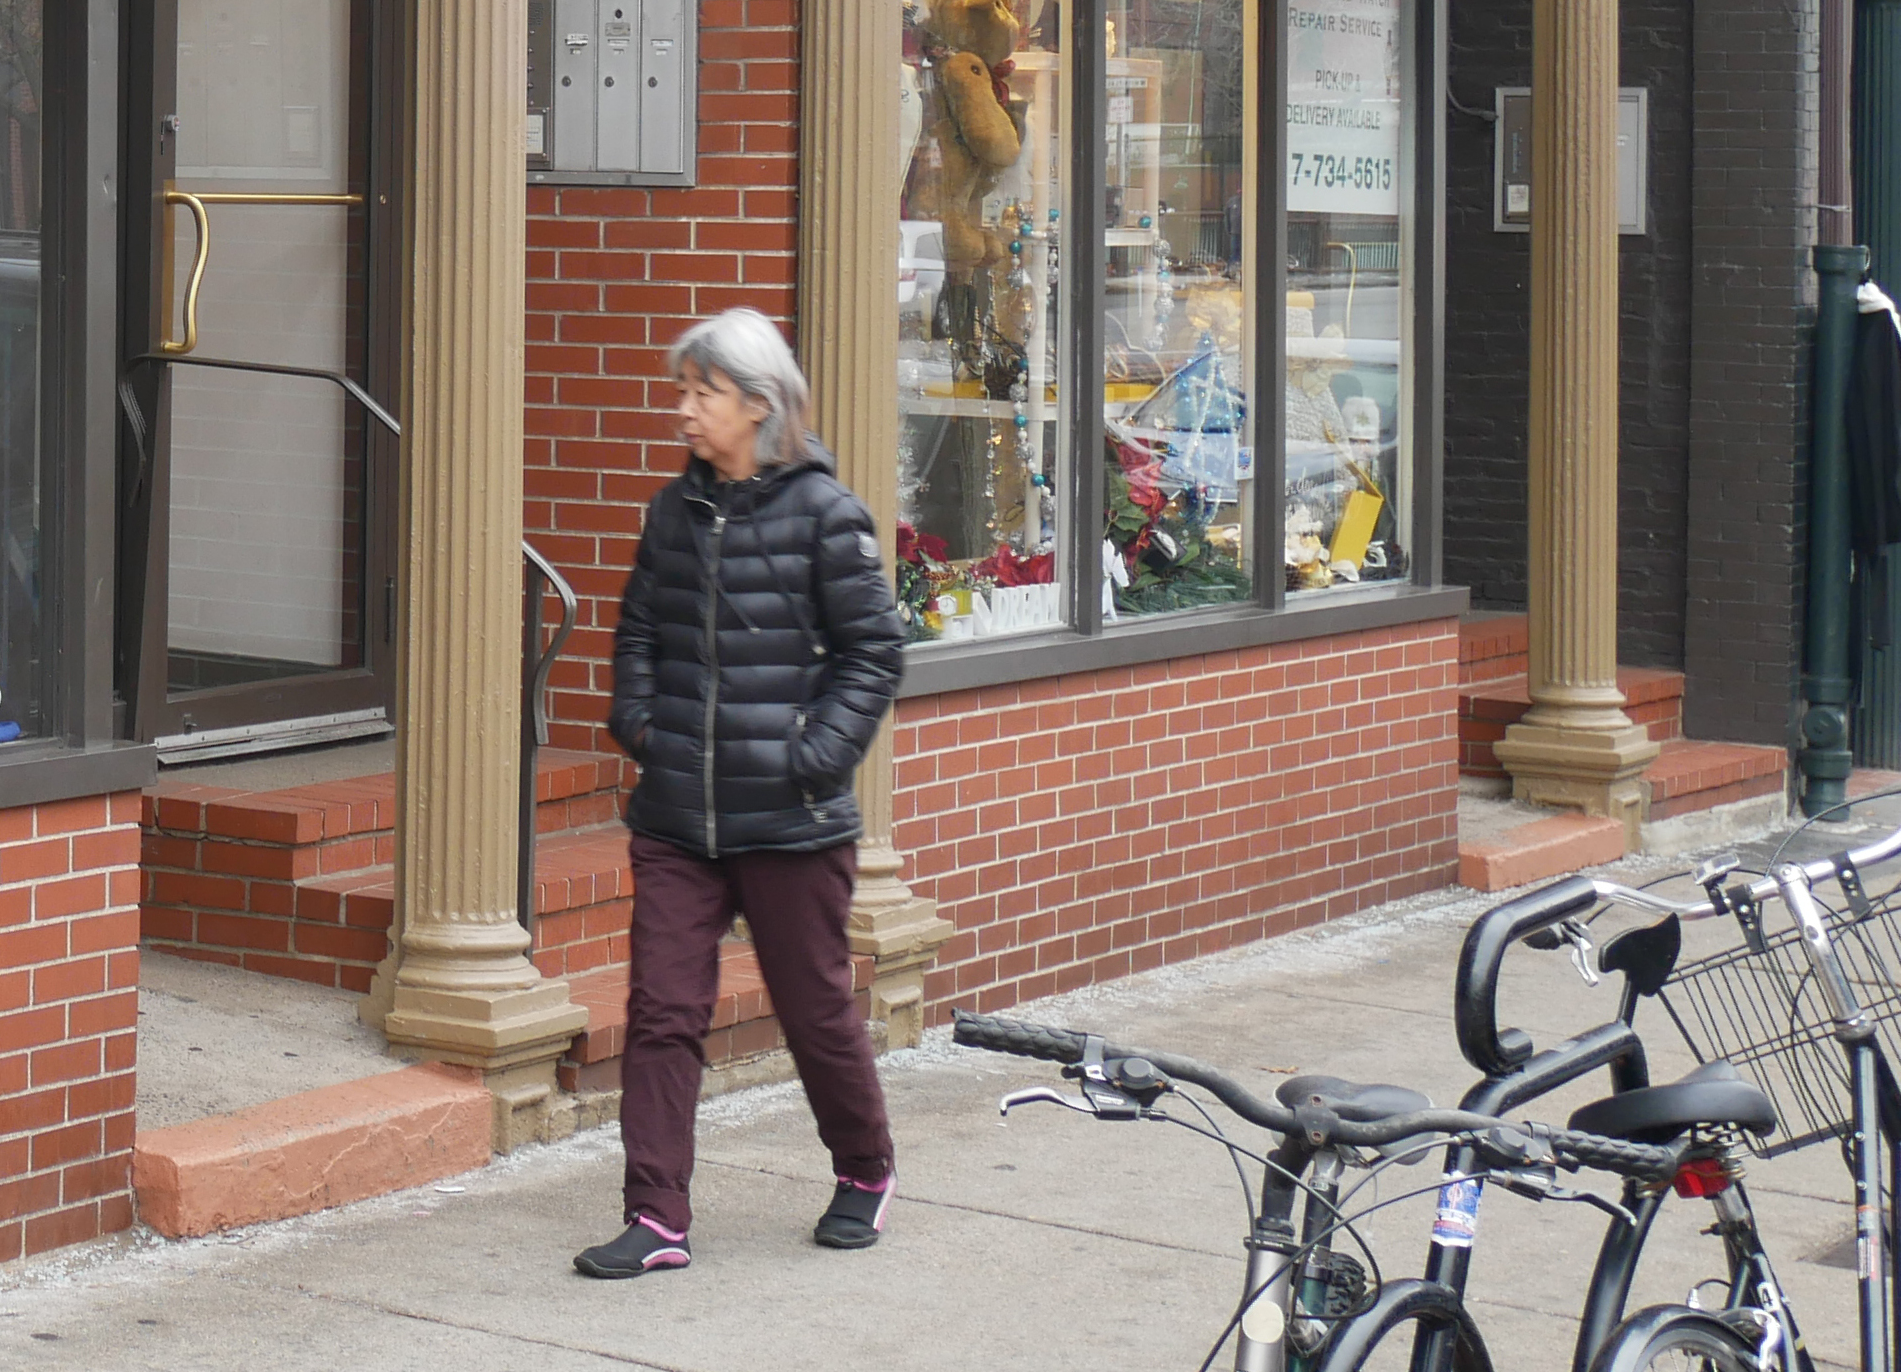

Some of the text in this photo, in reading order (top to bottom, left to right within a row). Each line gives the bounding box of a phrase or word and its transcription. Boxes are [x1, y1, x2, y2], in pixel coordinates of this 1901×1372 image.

[1288, 6, 1382, 38] REPAIR SERVICE
[1286, 103, 1381, 130] DELIVERY AVAILABLE
